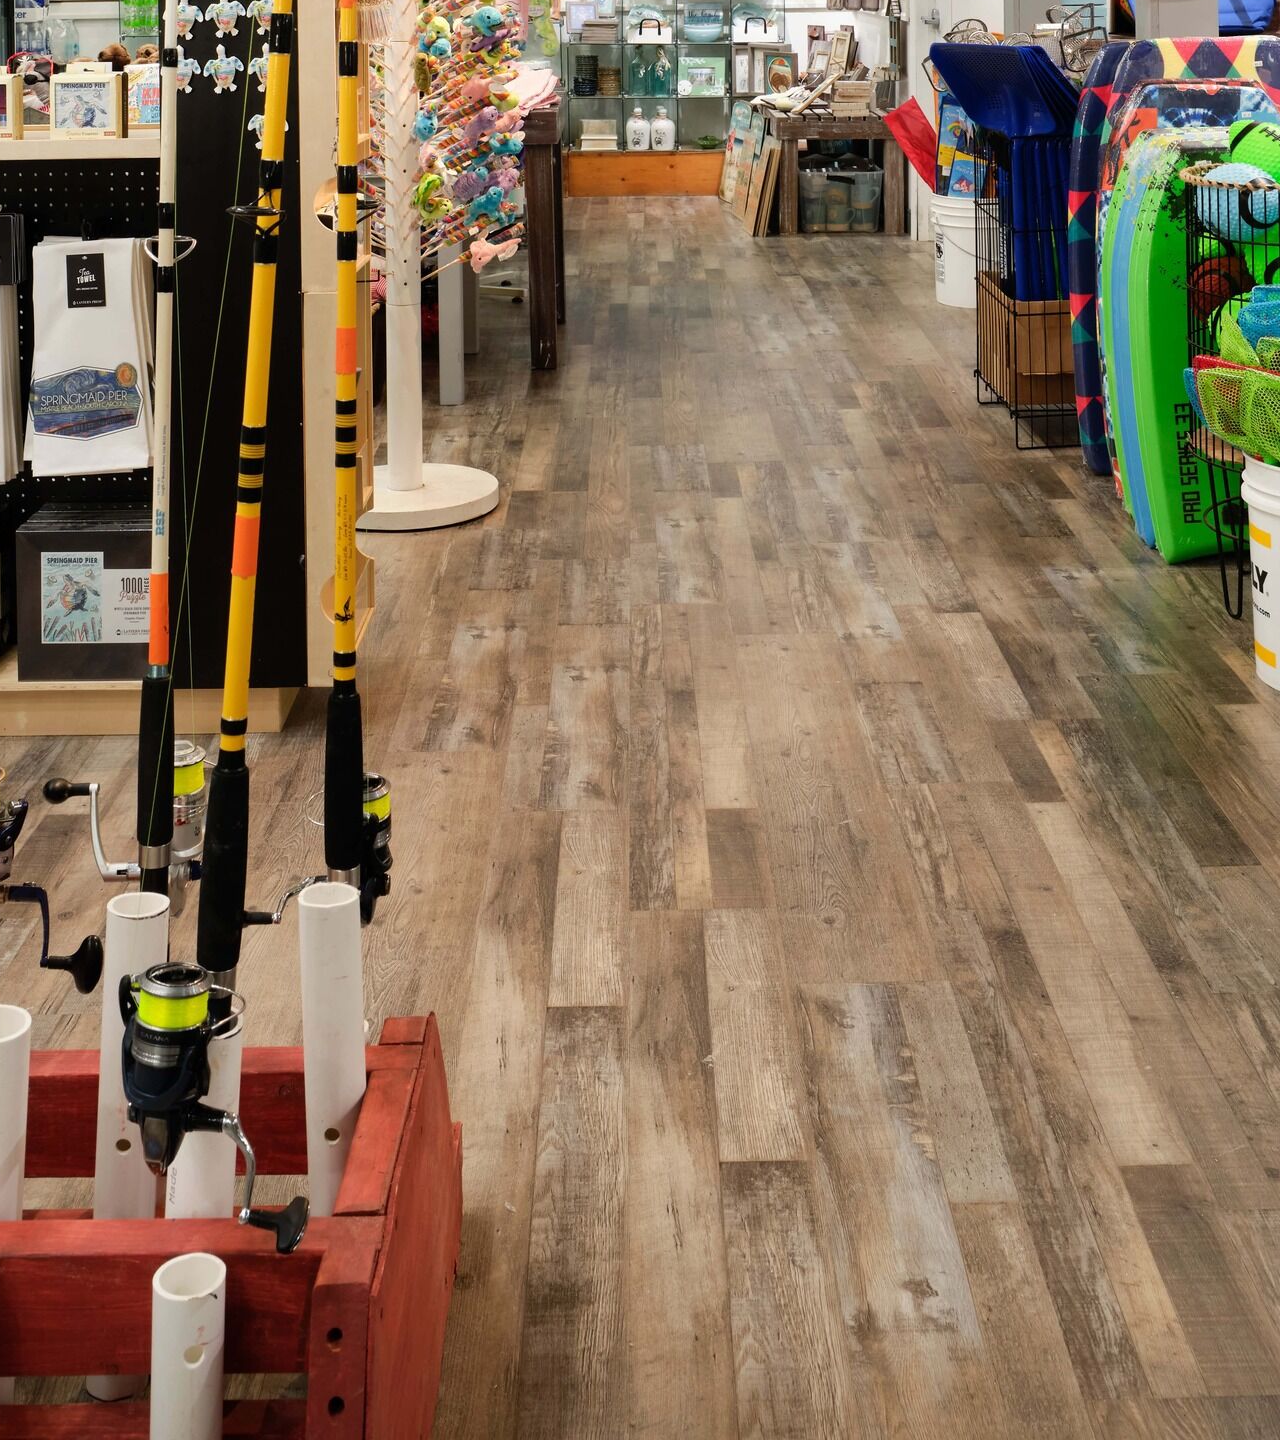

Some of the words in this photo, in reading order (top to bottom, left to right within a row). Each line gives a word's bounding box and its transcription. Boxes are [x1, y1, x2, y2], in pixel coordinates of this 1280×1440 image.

[76, 275, 96, 284] TOWEL
[41, 392, 105, 407] SPRINGMAID
[108, 390, 127, 401] PIER
[1176, 402, 1190, 424] 33
[1180, 428, 1196, 484] SERIES
[1183, 488, 1197, 524] PRO
[121, 577, 143, 594] 1000
[119, 591, 146, 606] Puzzle
[167, 1168, 178, 1204] Made
